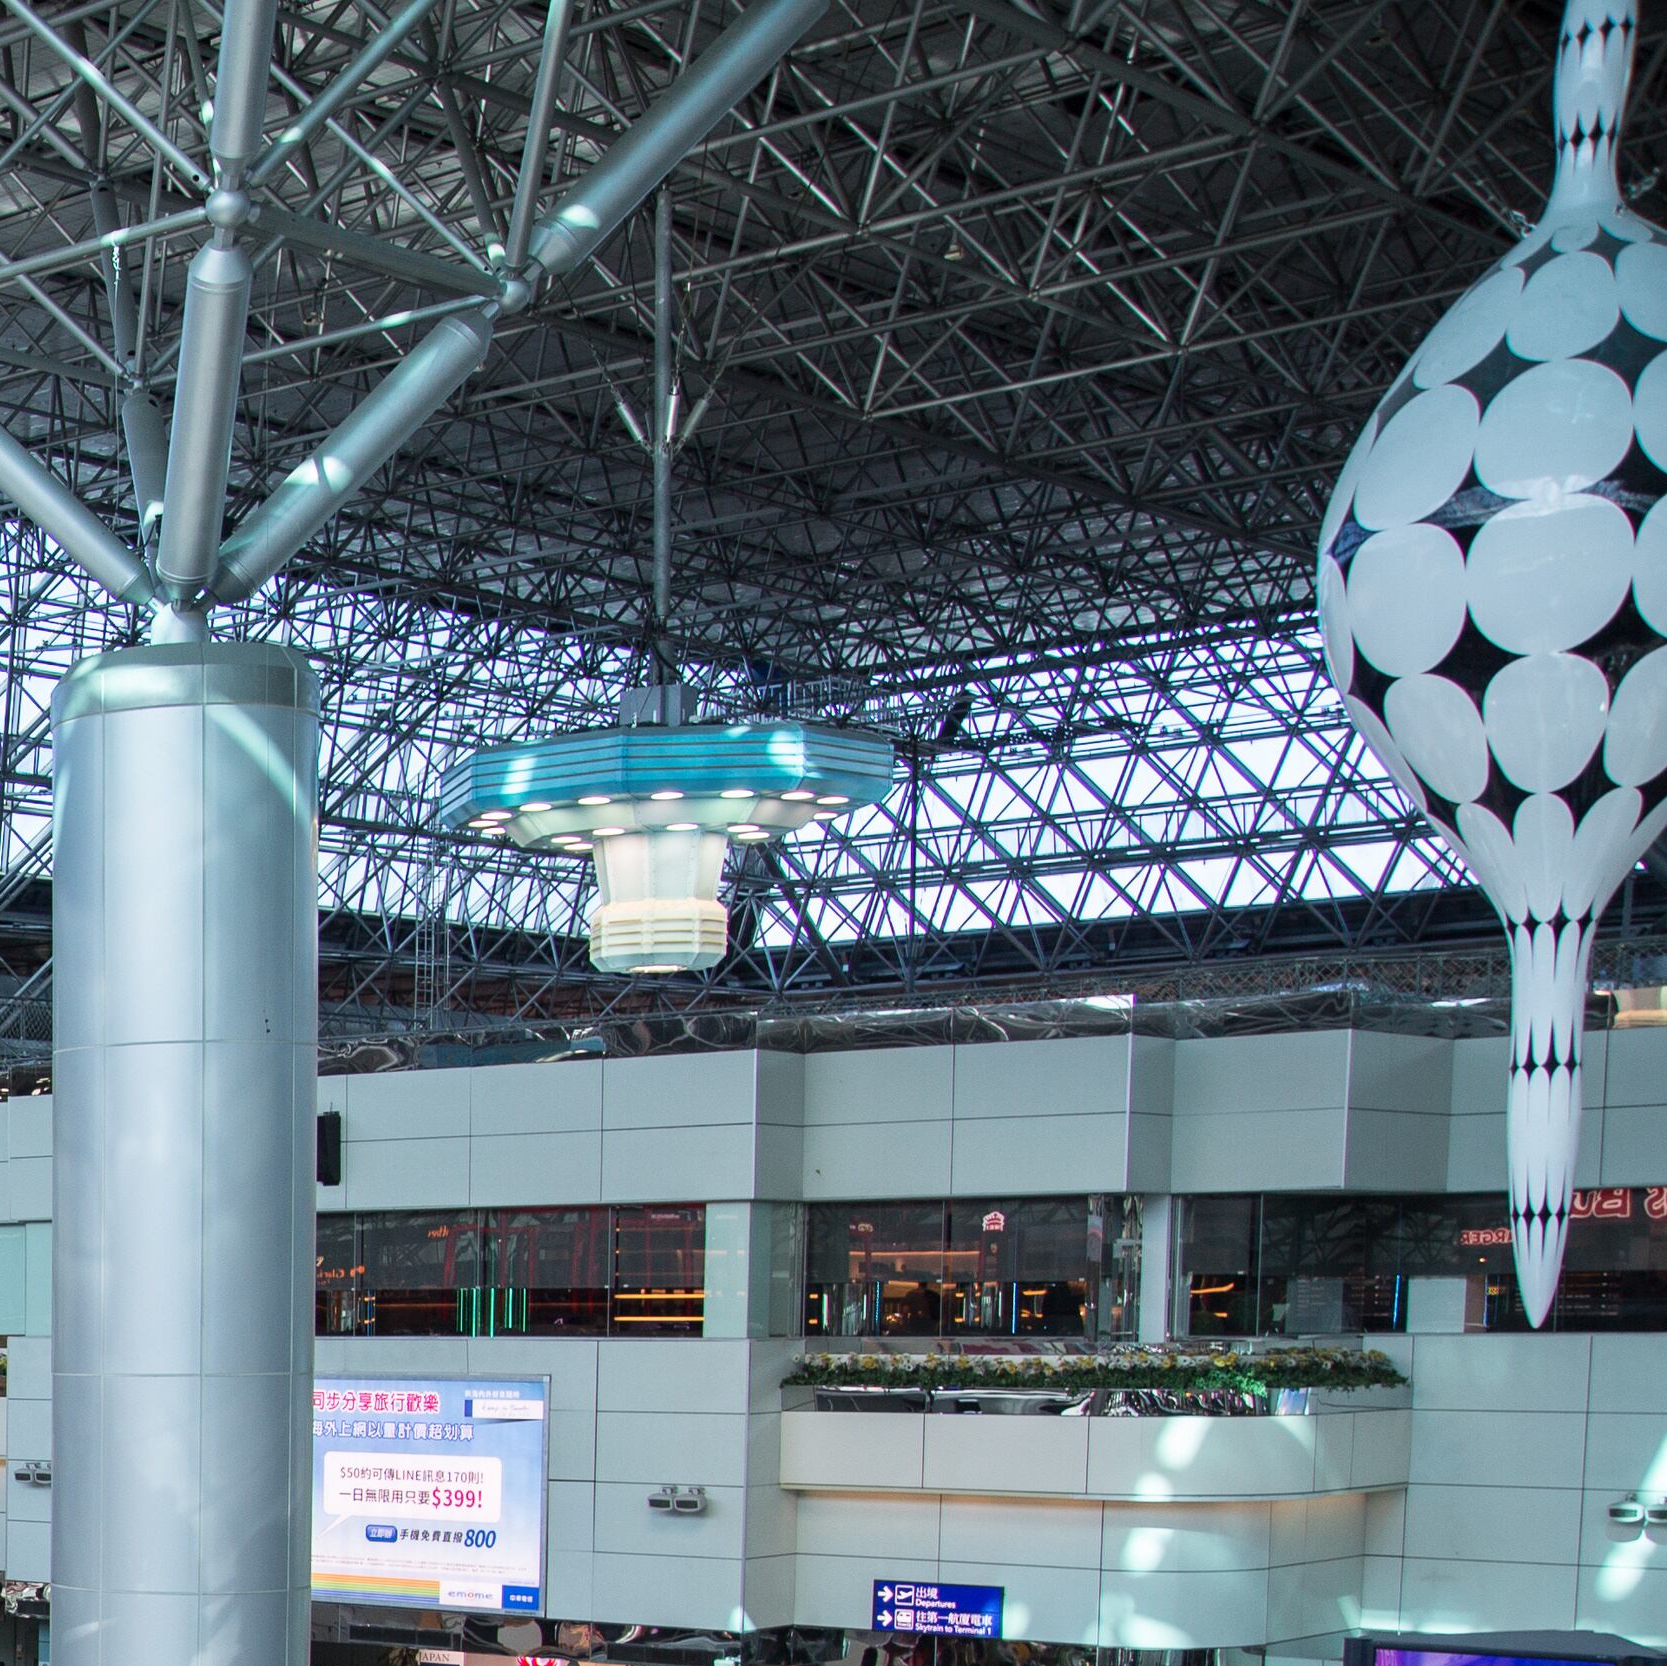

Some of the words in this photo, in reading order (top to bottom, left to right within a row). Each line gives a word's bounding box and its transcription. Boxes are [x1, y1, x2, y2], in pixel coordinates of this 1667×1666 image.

[448, 1590, 493, 1600] emome
[915, 1586, 938, 1600] 出境
[915, 1599, 955, 1610] Departures
[916, 1611, 993, 1627] 往第一航廈電車
[915, 1623, 943, 1633] Skytrain
[944, 1625, 953, 1633] to
[954, 1625, 986, 1636] Terminal
[987, 1627, 992, 1636] 1
